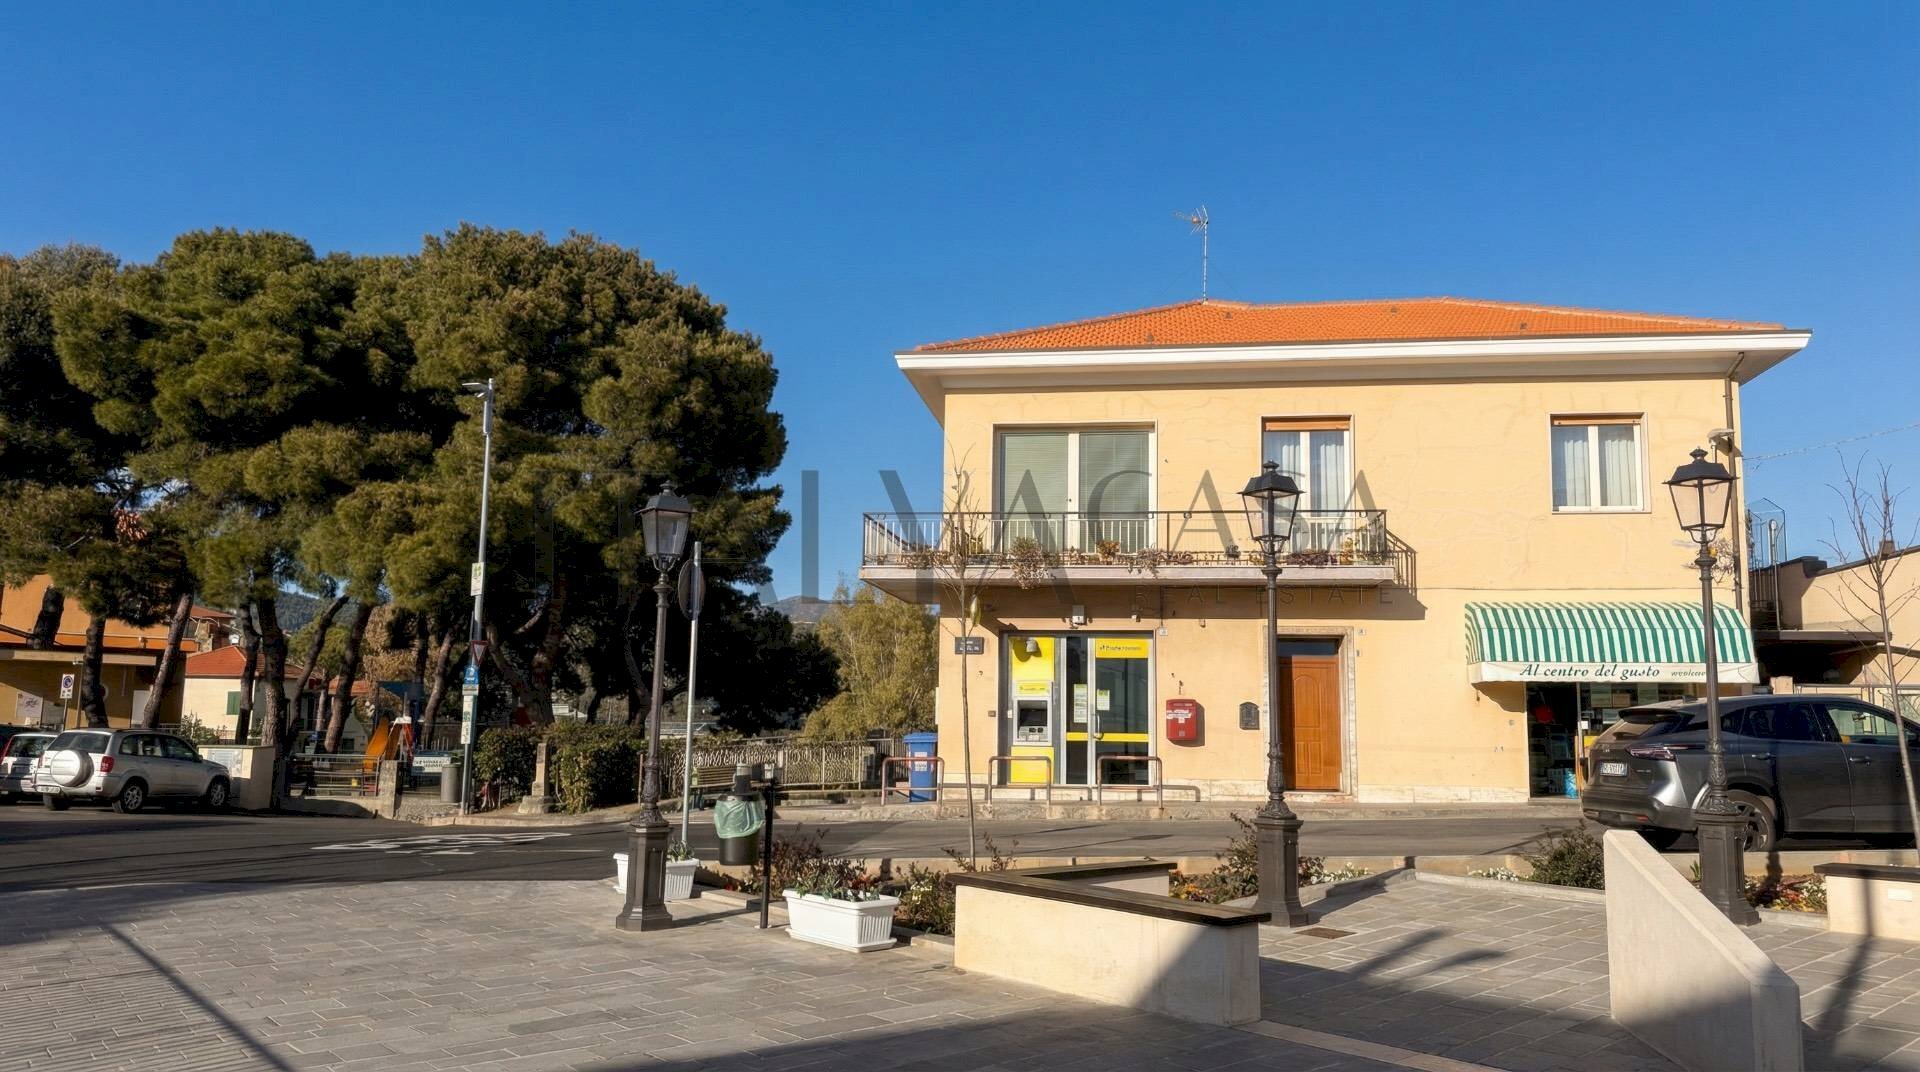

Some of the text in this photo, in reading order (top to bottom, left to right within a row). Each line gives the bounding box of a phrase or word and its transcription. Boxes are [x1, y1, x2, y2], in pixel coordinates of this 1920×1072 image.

[1520, 663, 1540, 677] Al
[1543, 665, 1589, 677] centro
[1594, 663, 1616, 677] del
[1620, 664, 1660, 681] gusto
